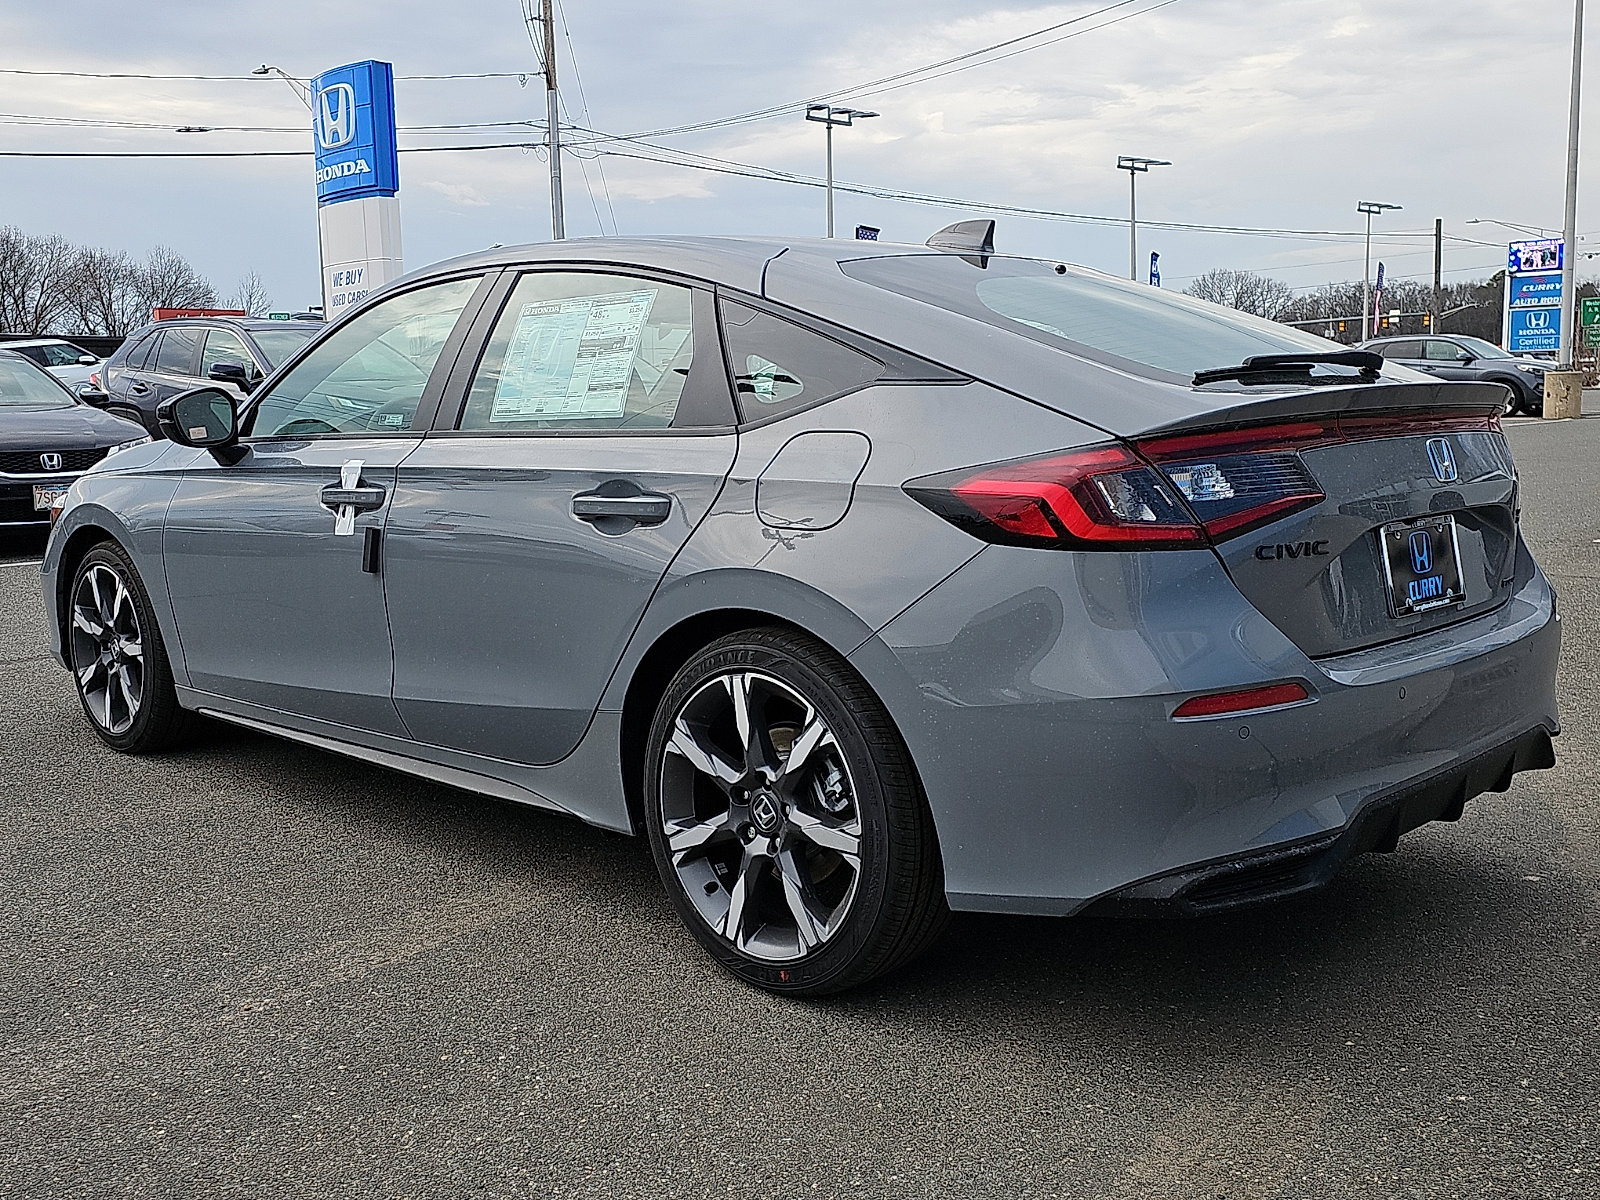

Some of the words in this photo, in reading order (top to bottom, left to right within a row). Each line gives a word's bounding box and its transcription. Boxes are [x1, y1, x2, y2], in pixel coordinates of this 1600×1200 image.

[316, 159, 371, 184] HONDA
[332, 271, 344, 287] WE
[345, 268, 364, 286] BUY
[1522, 282, 1563, 292] CURRY
[332, 293, 346, 307] USED
[1513, 297, 1539, 306] AUTO
[530, 306, 560, 315] HONDA
[1518, 328, 1556, 336] HONDA
[1519, 337, 1555, 346] Certified
[1255, 540, 1330, 560] CIVIC
[1408, 575, 1443, 601] CURRY
